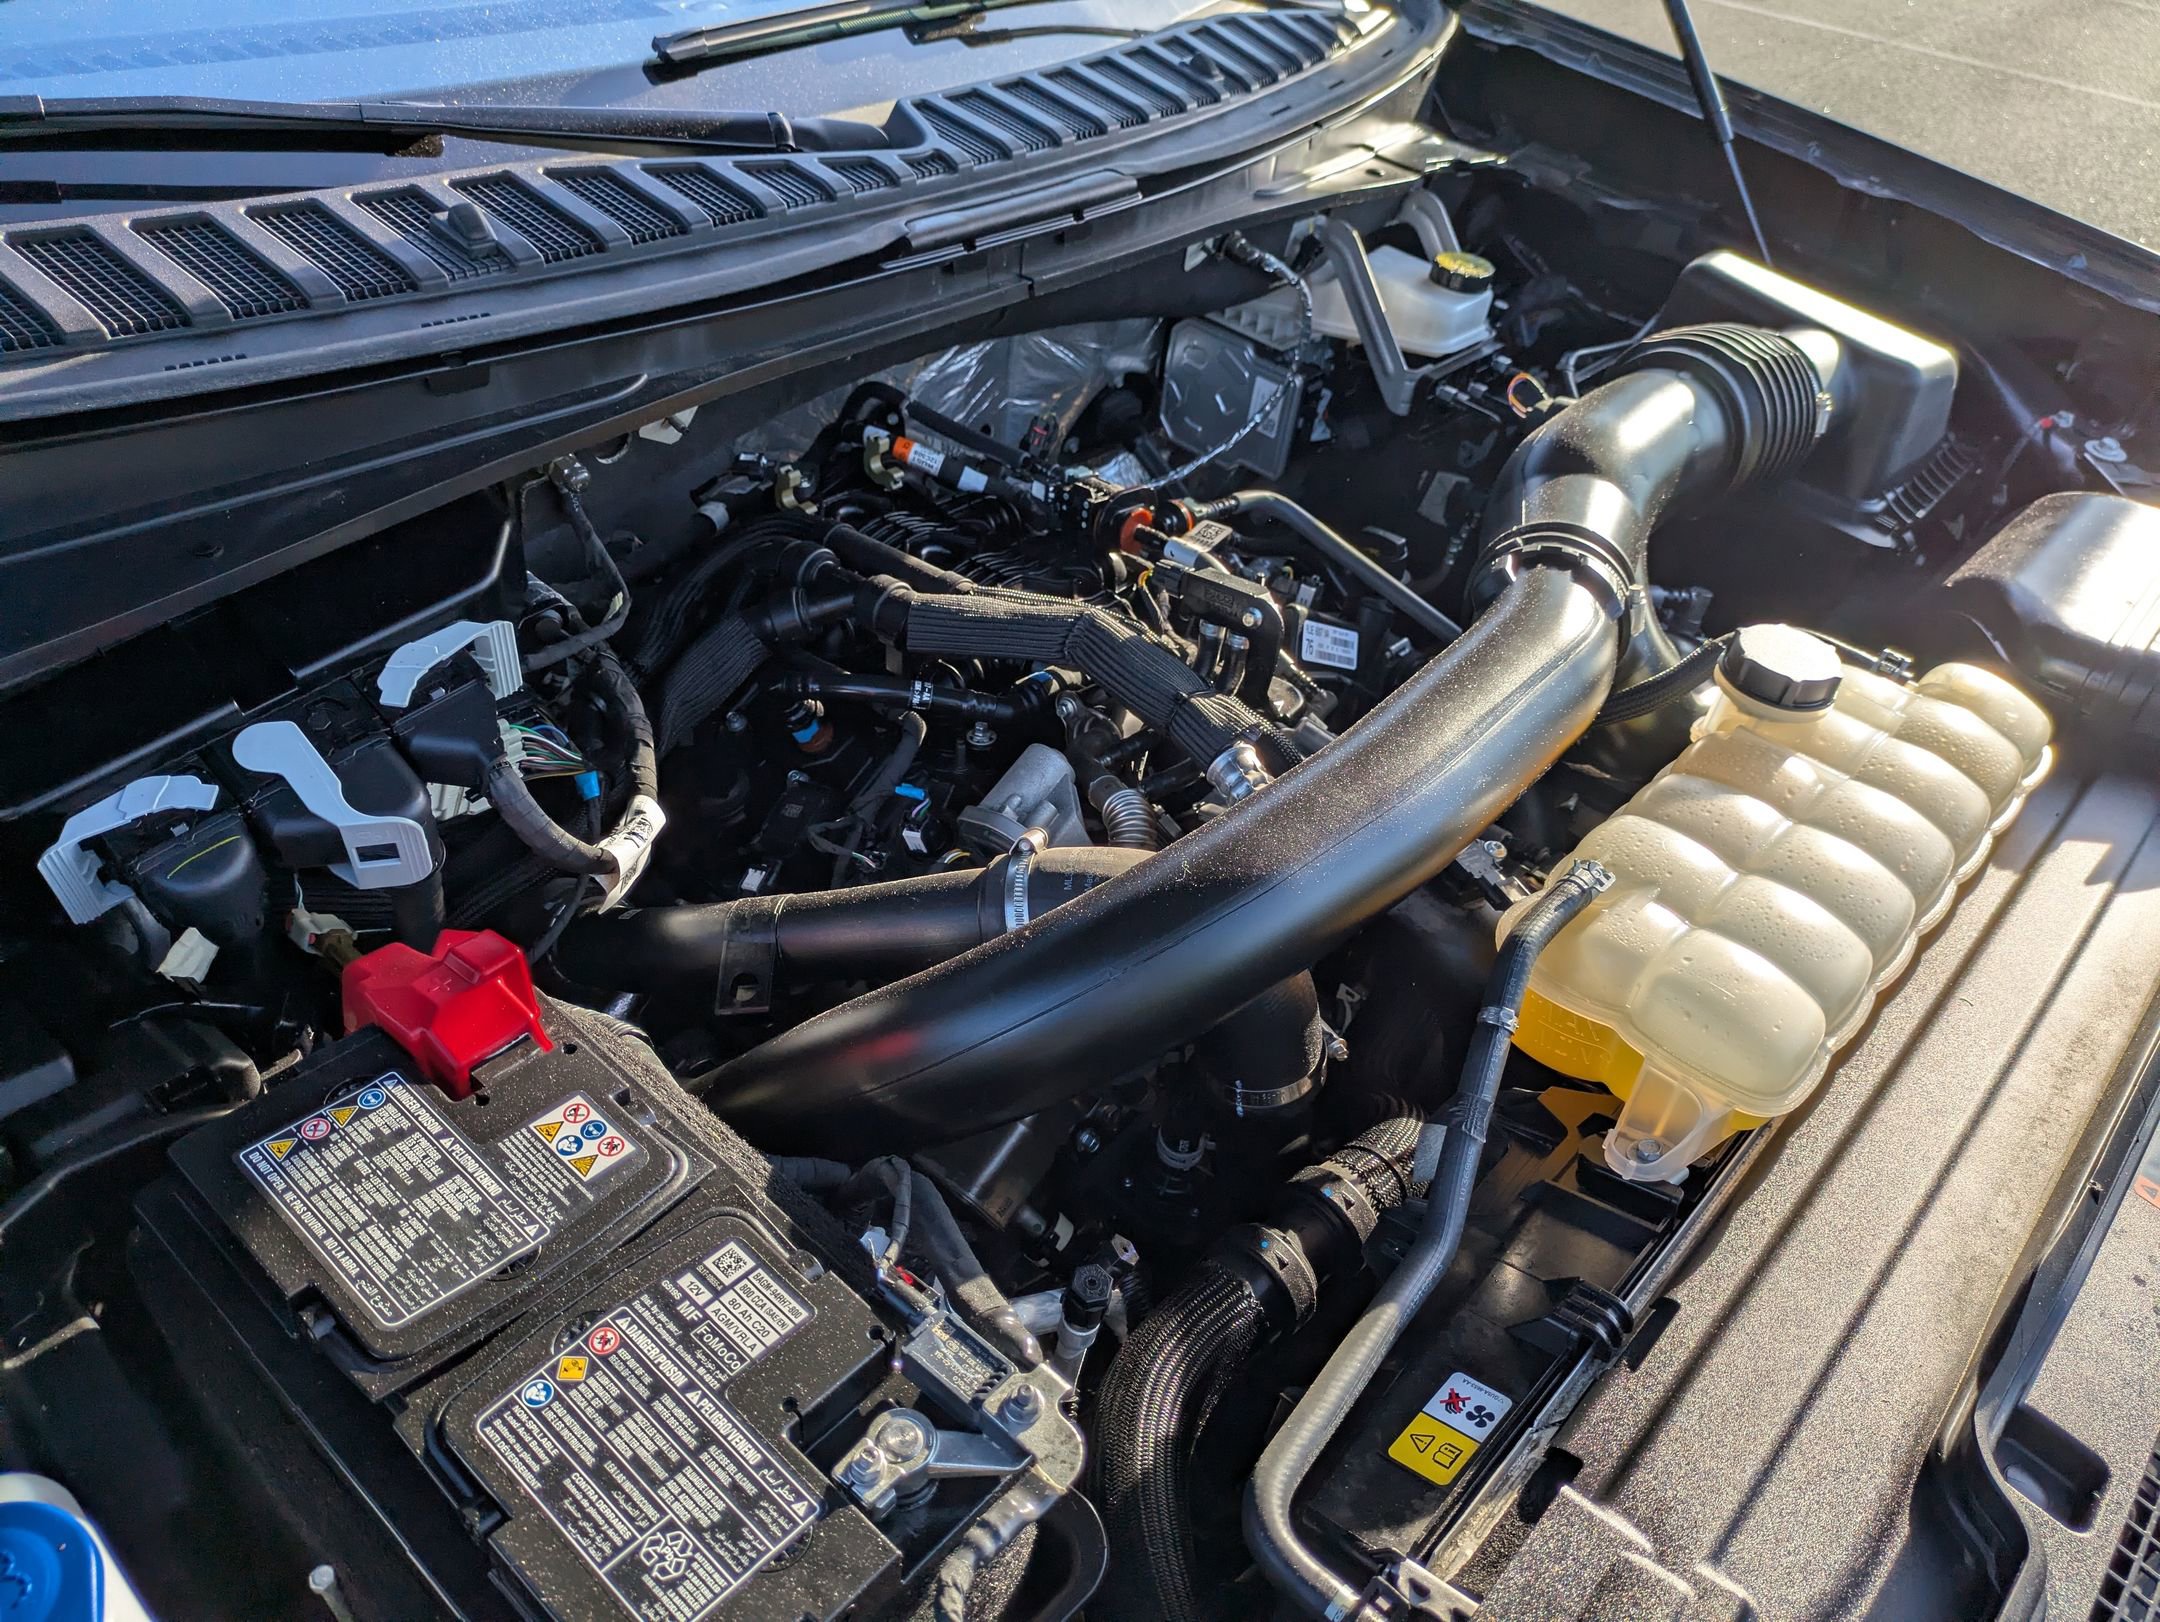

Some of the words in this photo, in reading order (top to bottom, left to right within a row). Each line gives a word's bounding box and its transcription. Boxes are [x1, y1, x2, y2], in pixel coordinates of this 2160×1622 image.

[367, 1111, 385, 1127] GASES
[375, 1107, 401, 1130] EXPLOSIVE
[390, 1084, 443, 1134] DANGER/POISON
[248, 1151, 263, 1163] DO
[387, 1146, 406, 1163] CAUSER
[400, 1160, 414, 1171] DES
[395, 1141, 421, 1165] EXPLOSIFS
[403, 1136, 416, 1146] LES
[410, 1144, 428, 1159] YEUX.
[422, 1157, 435, 1167] LES
[429, 1164, 443, 1176] GAZ
[410, 1131, 422, 1140] SE
[416, 1136, 444, 1161] PROTÉGER
[255, 1160, 273, 1175] NOT
[398, 1171, 409, 1179] ET
[403, 1176, 414, 1185] LA
[447, 1143, 503, 1197] PELIGRO/VENENO
[265, 1172, 288, 1193] OPEN.
[282, 1190, 298, 1203] NE
[451, 1174, 475, 1195] PROTEJA
[468, 1192, 482, 1203] LOS
[289, 1199, 307, 1214] PAS
[435, 1183, 465, 1212] EXPLOSIVOS
[443, 1179, 460, 1193] OJOS.
[454, 1190, 468, 1202] LOS
[462, 1199, 481, 1216] GASES
[299, 1210, 328, 1239] OUVRIR.
[322, 1237, 338, 1250] NO
[330, 1246, 347, 1260] LA
[338, 1255, 362, 1278] ABRA.
[684, 1279, 704, 1298] 12V
[752, 1271, 802, 1319] BAGM-94RH7-800
[676, 1299, 703, 1324] MF
[727, 1297, 742, 1311] 80
[737, 1307, 754, 1322] Ah
[749, 1319, 771, 1339] C20
[738, 1283, 755, 1298] 800
[750, 1294, 767, 1310] CCA
[762, 1306, 789, 1331] (SAE/EN)
[710, 1306, 758, 1352] AGM/VRLA
[624, 1323, 688, 1387] DANGER/POISON
[631, 1299, 646, 1313] Ford
[641, 1309, 658, 1326] Motor
[701, 1372, 720, 1389] 48121
[695, 1324, 743, 1371] FoMoCo
[607, 1354, 626, 1372] REACH
[620, 1367, 632, 1378] OF
[615, 1347, 631, 1362] KEEP
[625, 1358, 639, 1371] OUT
[639, 1372, 653, 1385] THE
[658, 1392, 676, 1410] TENIR
[671, 1405, 687, 1421] HORS
[510, 1404, 560, 1457] NON-SPILLABLE
[540, 1406, 557, 1422] LIRE
[551, 1417, 564, 1431] LES
[559, 1427, 597, 1467] INSTRUCTIONS.
[549, 1400, 567, 1417] READ
[561, 1413, 599, 1452] INSTRUCTIONS.
[650, 1398, 672, 1420] PORTÉE
[665, 1416, 679, 1429] DES
[673, 1424, 699, 1450] ENFANTS.
[682, 1417, 693, 1428] DE
[687, 1423, 699, 1434] LA
[694, 1397, 763, 1465] PELIGRO/VENENO
[492, 1418, 518, 1445] Batterie
[513, 1443, 523, 1453] au
[519, 1450, 541, 1473] plomb
[502, 1410, 520, 1428] Lead
[516, 1425, 533, 1442] Acid
[526, 1439, 552, 1466] Battery
[482, 1424, 501, 1443] ANTI
[496, 1439, 544, 1491] DÉVERSEMENT
[698, 1451, 710, 1463] DE
[704, 1458, 719, 1471] LOS
[707, 1443, 732, 1467] ALÉJESE
[725, 1462, 739, 1476] DEL
[733, 1471, 758, 1496] ALCANCE
[569, 1471, 599, 1502] CONTRA
[594, 1499, 632, 1539] DERRAMES
[602, 1460, 617, 1474] LEA
[611, 1469, 626, 1484] LAS
[620, 1479, 662, 1523] INSTRUCCIONES.
[579, 1497, 591, 1508] de
[585, 1504, 607, 1527] plomo
[659, 1545, 675, 1561] Pb
